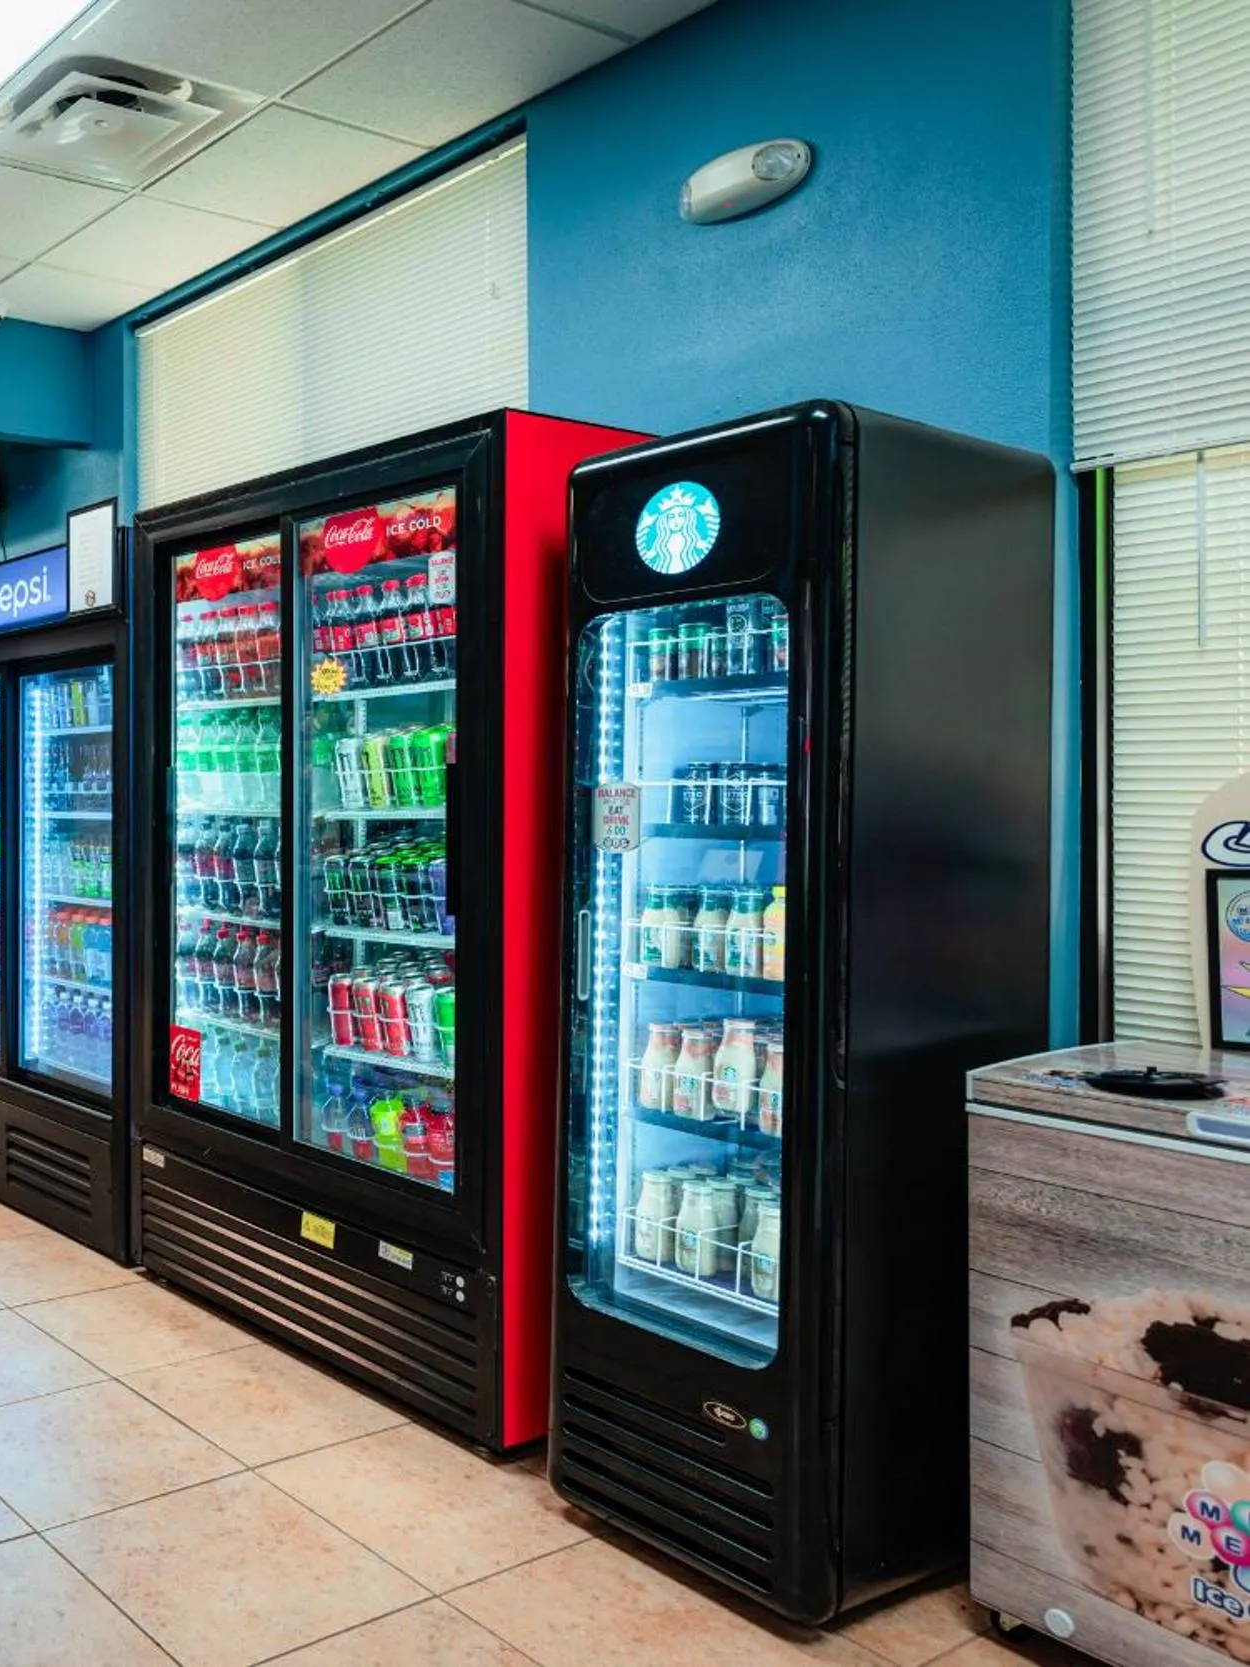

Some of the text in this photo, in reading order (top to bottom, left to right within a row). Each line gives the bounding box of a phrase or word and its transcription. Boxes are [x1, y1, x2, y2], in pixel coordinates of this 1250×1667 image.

[325, 517, 375, 549] Coca-Cola
[386, 516, 442, 537] ICE COLD
[196, 553, 235, 579] Coca-Cola
